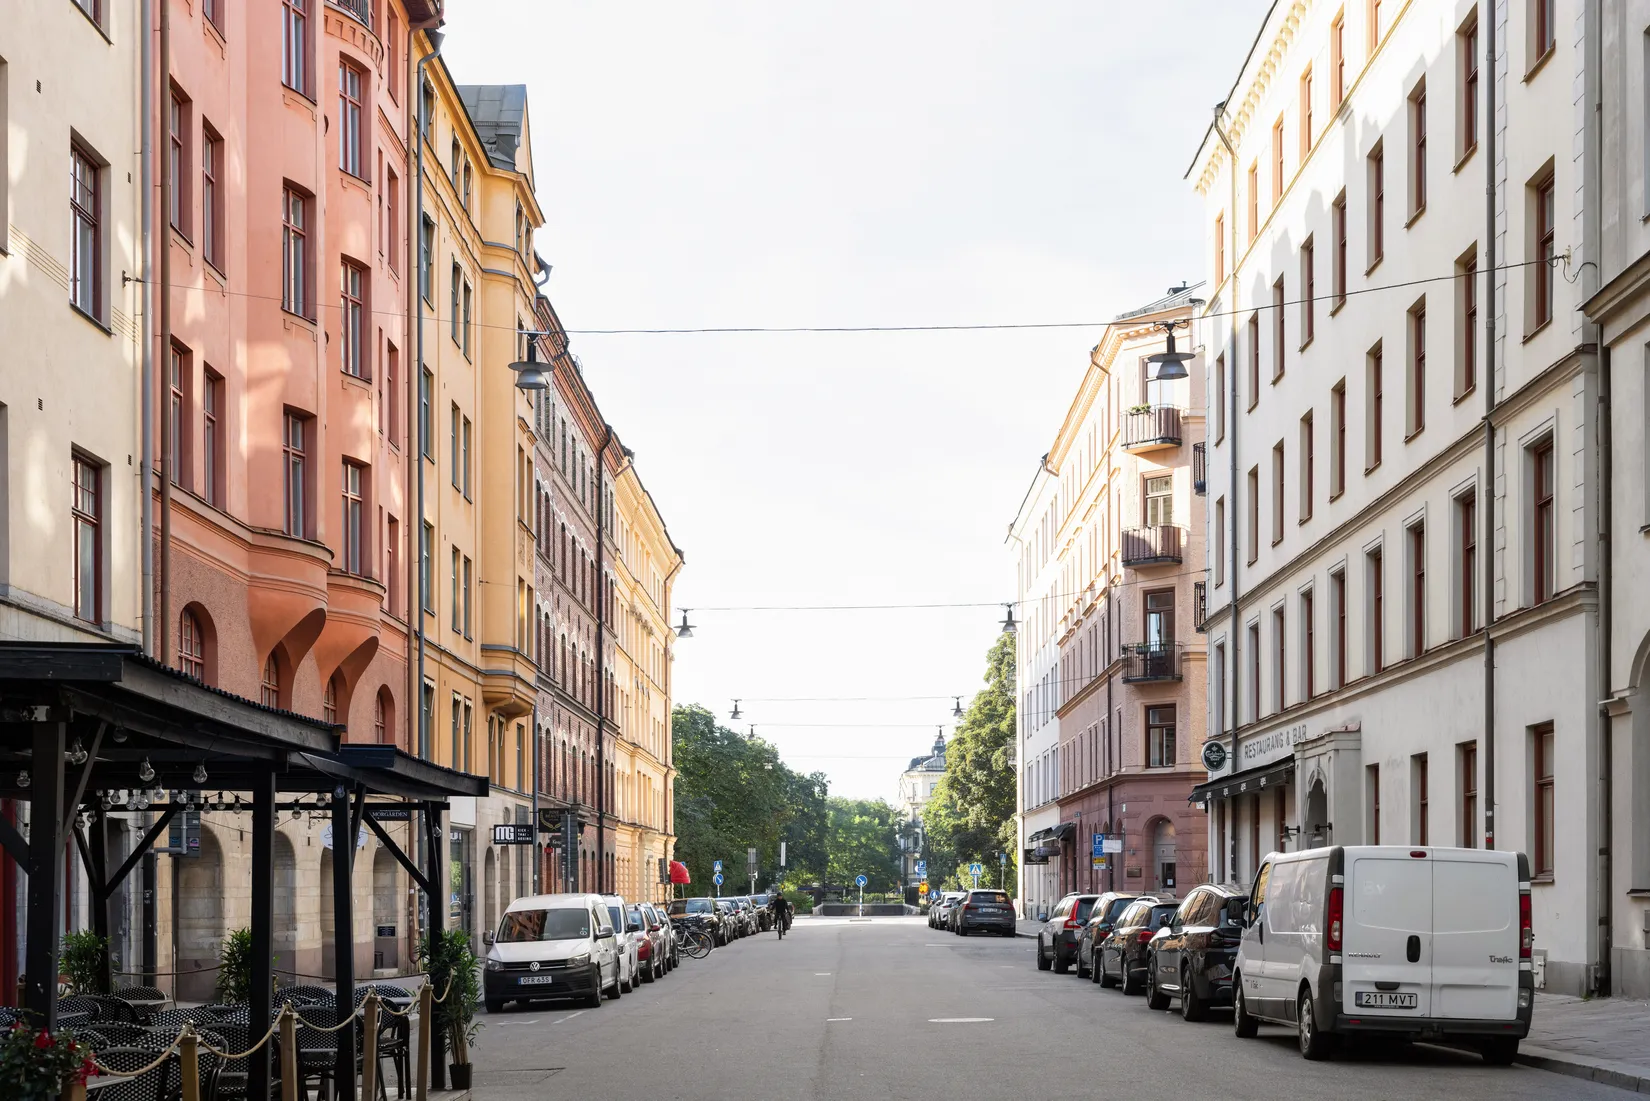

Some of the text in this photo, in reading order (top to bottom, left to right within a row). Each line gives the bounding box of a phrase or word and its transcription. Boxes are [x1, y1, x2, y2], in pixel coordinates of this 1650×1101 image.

[1244, 731, 1284, 759] RESTAURANG
[1292, 724, 1307, 743] BAR
[496, 826, 514, 840] MG
[1096, 835, 1103, 845] P
[1488, 954, 1513, 964] Trafic
[1364, 993, 1414, 1006] 211 MVT
